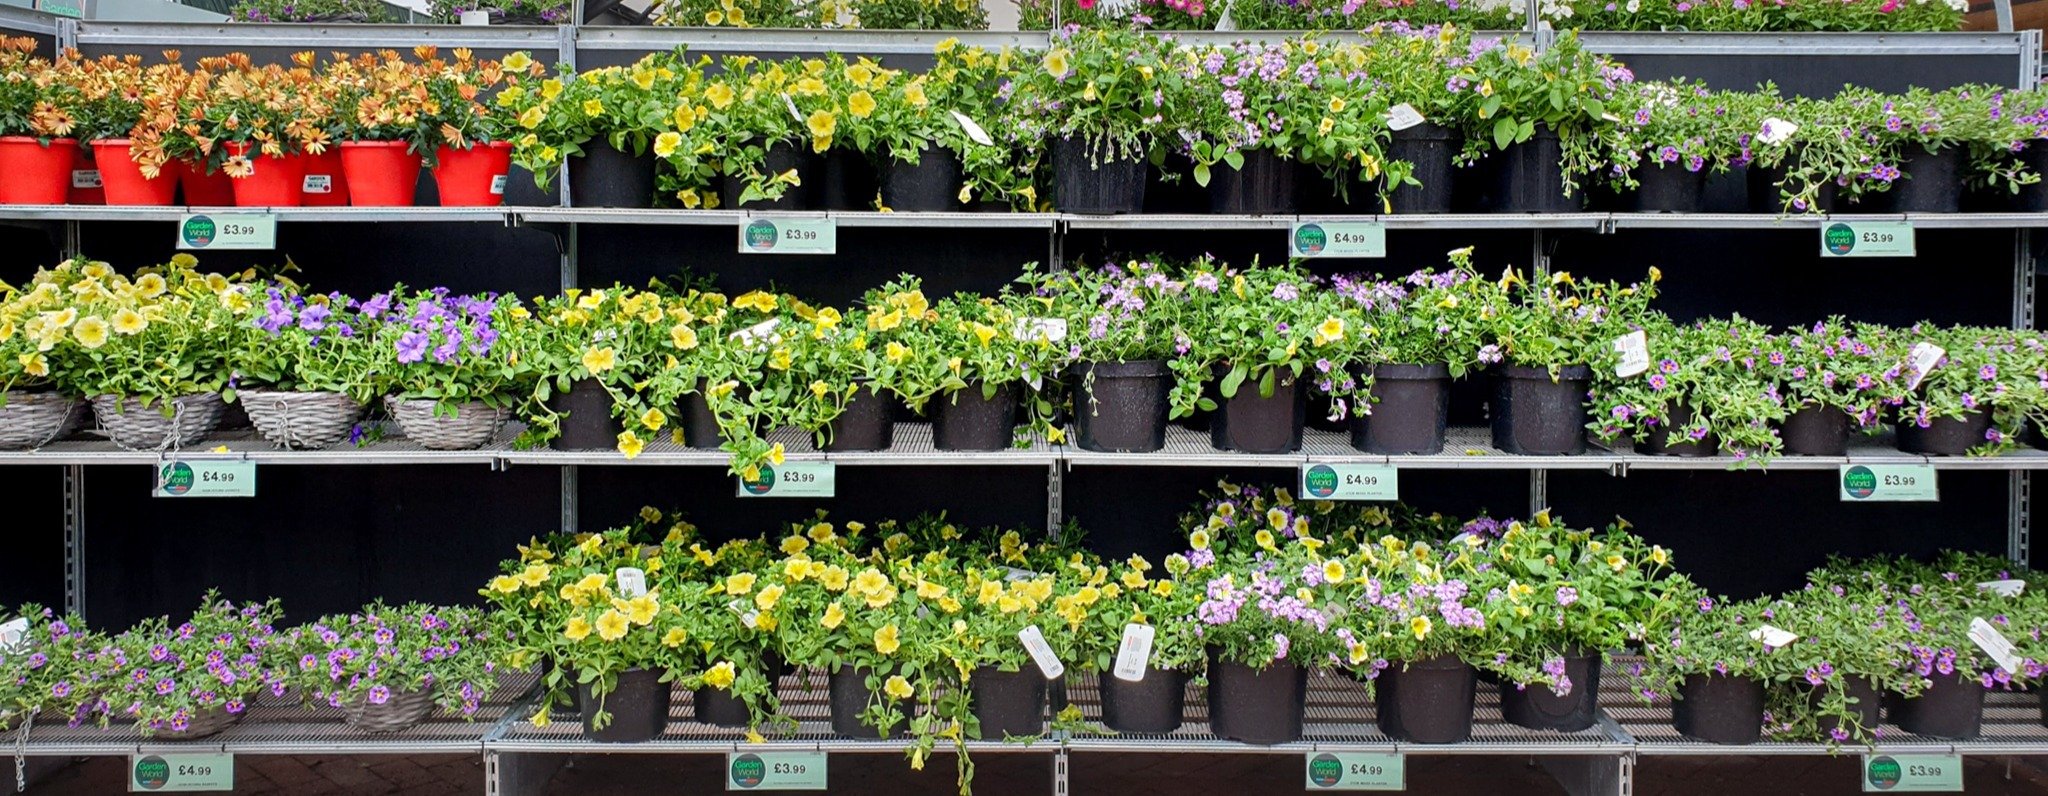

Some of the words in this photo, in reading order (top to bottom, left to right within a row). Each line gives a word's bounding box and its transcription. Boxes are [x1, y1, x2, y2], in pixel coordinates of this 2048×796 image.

[187, 221, 213, 229] Garden
[223, 224, 254, 235] £3.99
[785, 229, 816, 240] £3.99
[1827, 229, 1852, 237] Garden
[1863, 232, 1894, 243] £3.99
[1334, 233, 1365, 243] £4.99
[203, 471, 234, 482] £4.99
[783, 471, 815, 482] £3.99
[1308, 471, 1335, 479] Garden
[1346, 474, 1377, 485] £4.99
[1846, 472, 1873, 480] Garden
[1311, 478, 1332, 486] World
[1850, 479, 1870, 487] World
[1884, 475, 1915, 486] £3.99
[138, 762, 166, 771] Garden
[734, 760, 762, 769] Garden
[774, 763, 806, 774] £3.99
[1312, 760, 1339, 768] Garden
[1871, 762, 1898, 771] Garden
[178, 764, 211, 776] £4.99
[738, 768, 759, 776] World
[1315, 767, 1336, 775] World
[1351, 763, 1383, 775] £4.99
[1909, 765, 1941, 776] £3.99
[141, 770, 163, 778] World
[1874, 770, 1895, 778] World
